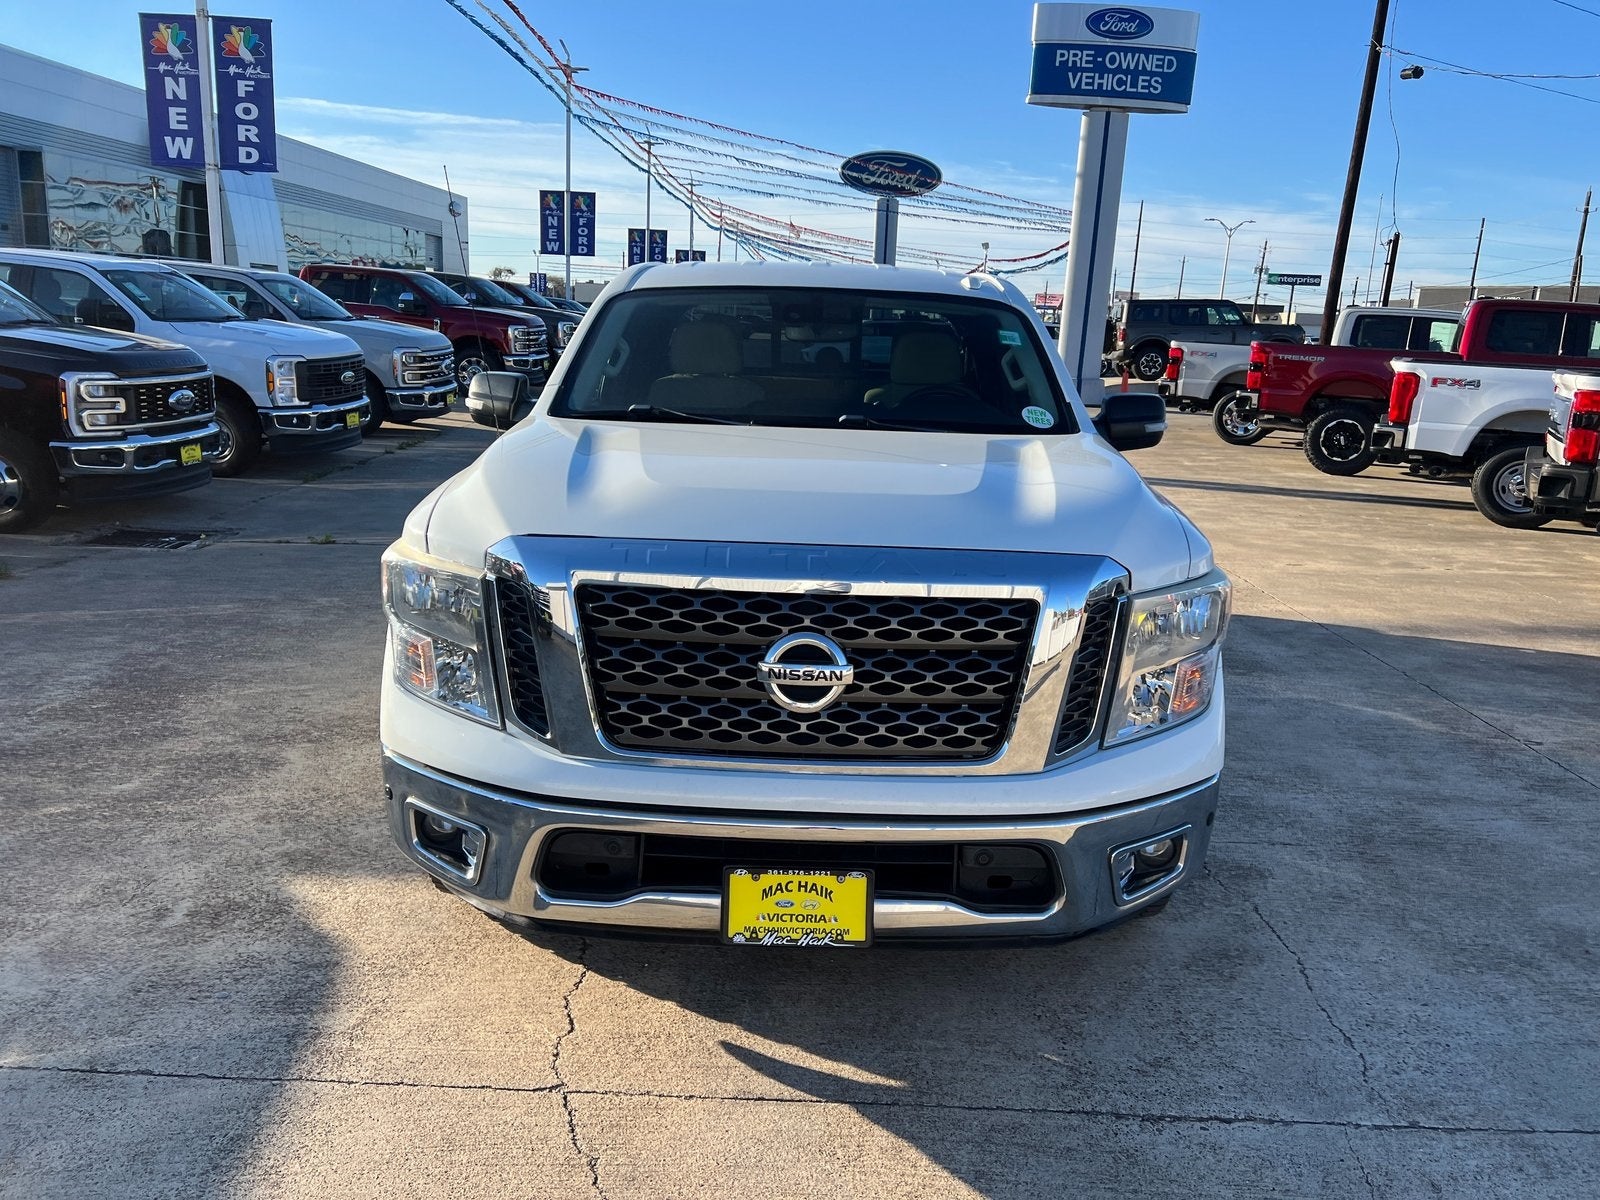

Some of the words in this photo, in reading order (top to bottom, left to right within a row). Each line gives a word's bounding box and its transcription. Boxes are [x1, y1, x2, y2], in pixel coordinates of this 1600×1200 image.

[1099, 12, 1140, 33] Ford
[1068, 72, 1162, 94] VEHICLES
[163, 76, 194, 160] NEW
[234, 79, 260, 164] FORD
[861, 160, 922, 187] Ford
[546, 216, 560, 252] NEW
[577, 218, 589, 254] FORD
[633, 247, 641, 263] NE
[1270, 275, 1321, 285] enterprise
[1190, 350, 1218, 358] FX4
[1278, 353, 1326, 362] TREMOR
[1430, 376, 1481, 389] FX4
[1027, 408, 1047, 417] NEW
[1025, 416, 1052, 426] TIRES
[767, 668, 844, 682] NISSAN
[761, 880, 794, 901] MAC
[797, 881, 834, 903] HAIK
[766, 913, 828, 924] VICTORIA
[760, 932, 794, 946] Mac
[797, 932, 836, 946] Haik
